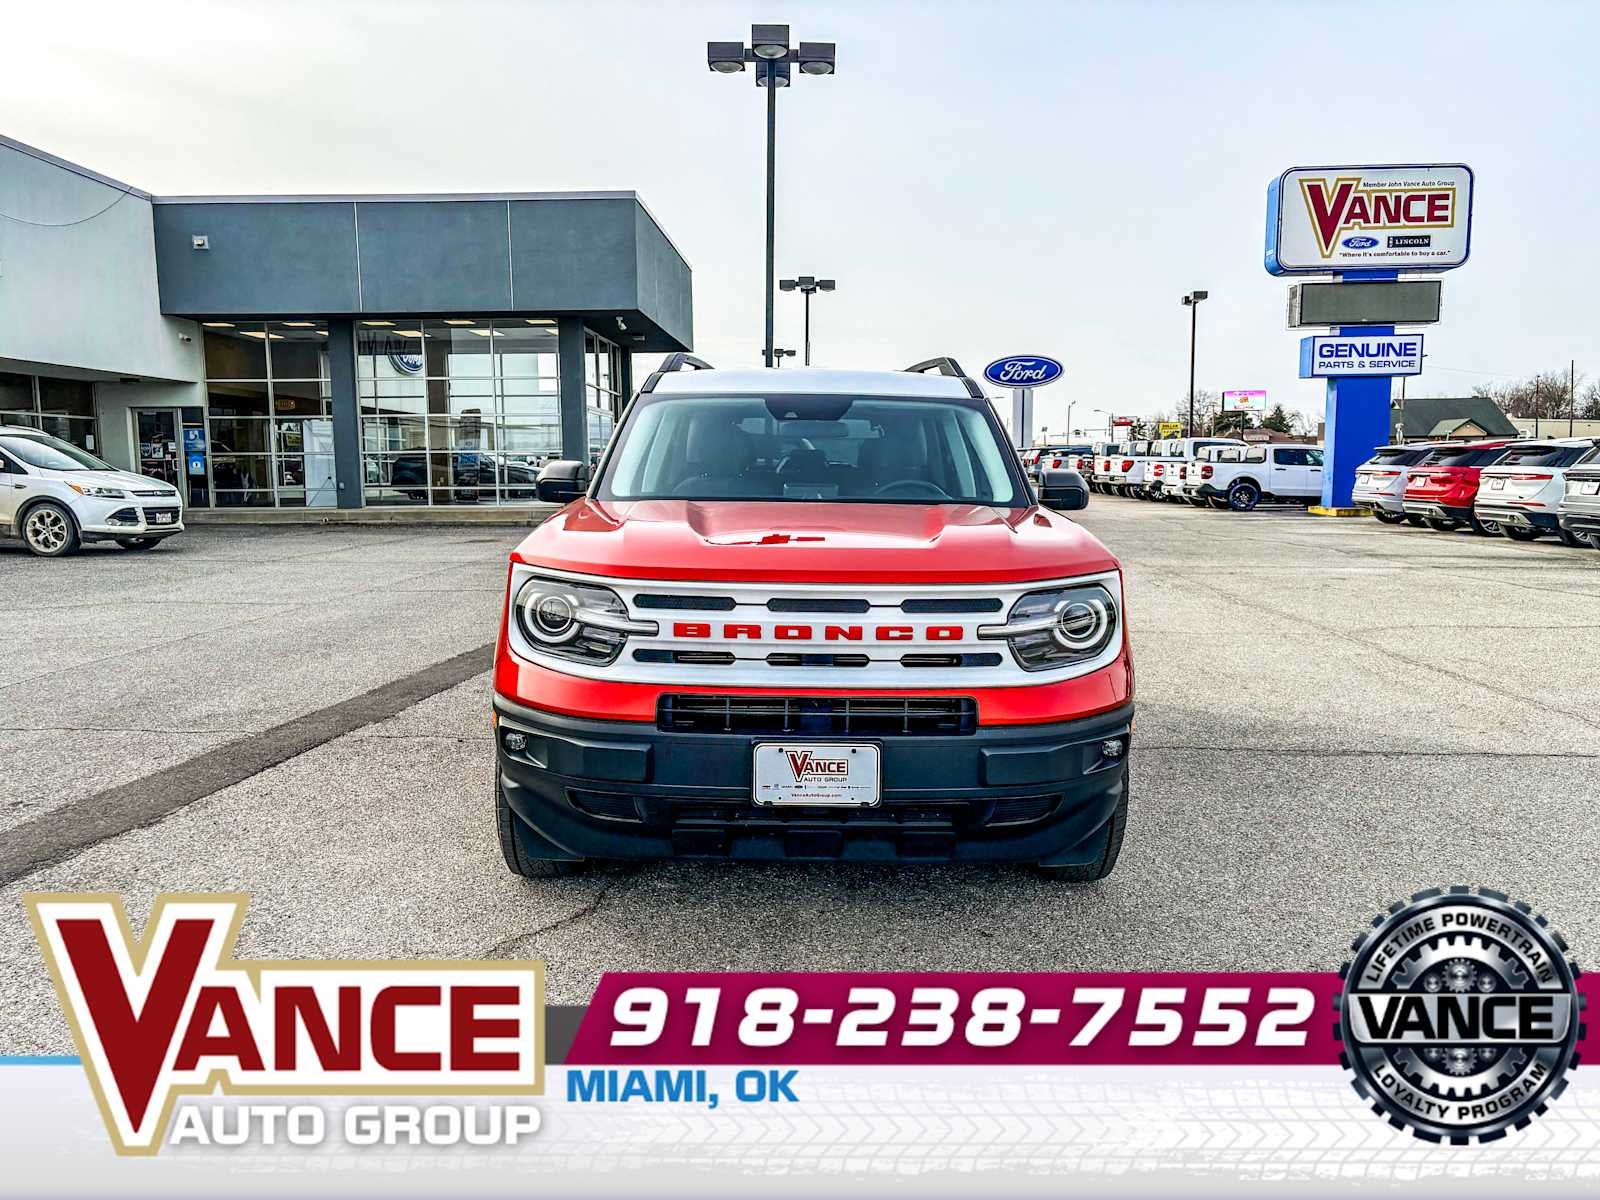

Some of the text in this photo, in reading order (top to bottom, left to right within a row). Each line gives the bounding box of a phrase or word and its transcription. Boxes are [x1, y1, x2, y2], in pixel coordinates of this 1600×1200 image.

[1437, 179, 1455, 187] Group
[1306, 183, 1450, 251] VANCE
[1348, 237, 1372, 248] Ford
[1318, 342, 1417, 358] GENUINE
[1000, 360, 1048, 381] Ford
[1318, 359, 1416, 369] PARTS & SERVICE
[672, 622, 964, 641] BRONCO
[789, 753, 846, 779] VANCE
